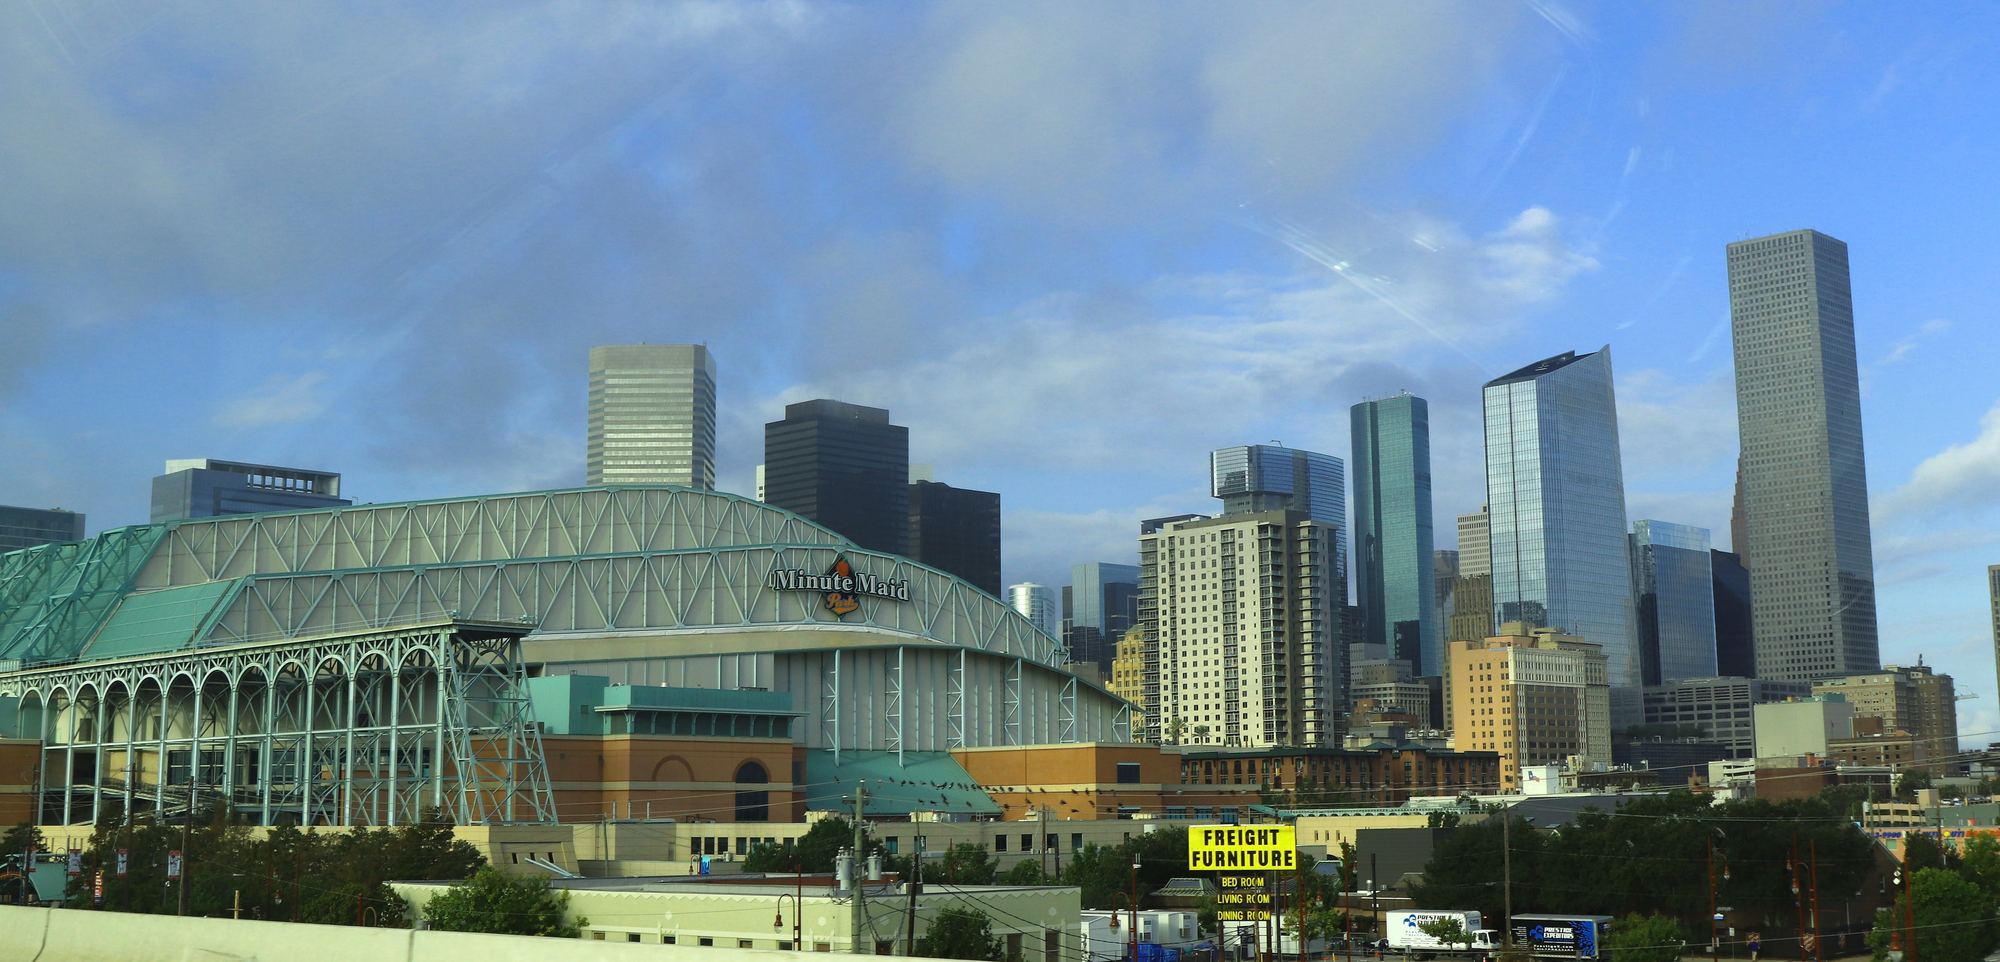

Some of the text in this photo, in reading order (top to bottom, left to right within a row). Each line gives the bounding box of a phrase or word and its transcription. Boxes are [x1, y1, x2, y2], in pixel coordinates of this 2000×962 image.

[775, 569, 910, 601] Minute Maid
[1203, 829, 1280, 846] FREIGHT
[1192, 850, 1293, 867] FURNITURE
[1222, 877, 1238, 887] BED
[1217, 894, 1243, 904] LIVING
[1217, 911, 1243, 921] DINING
